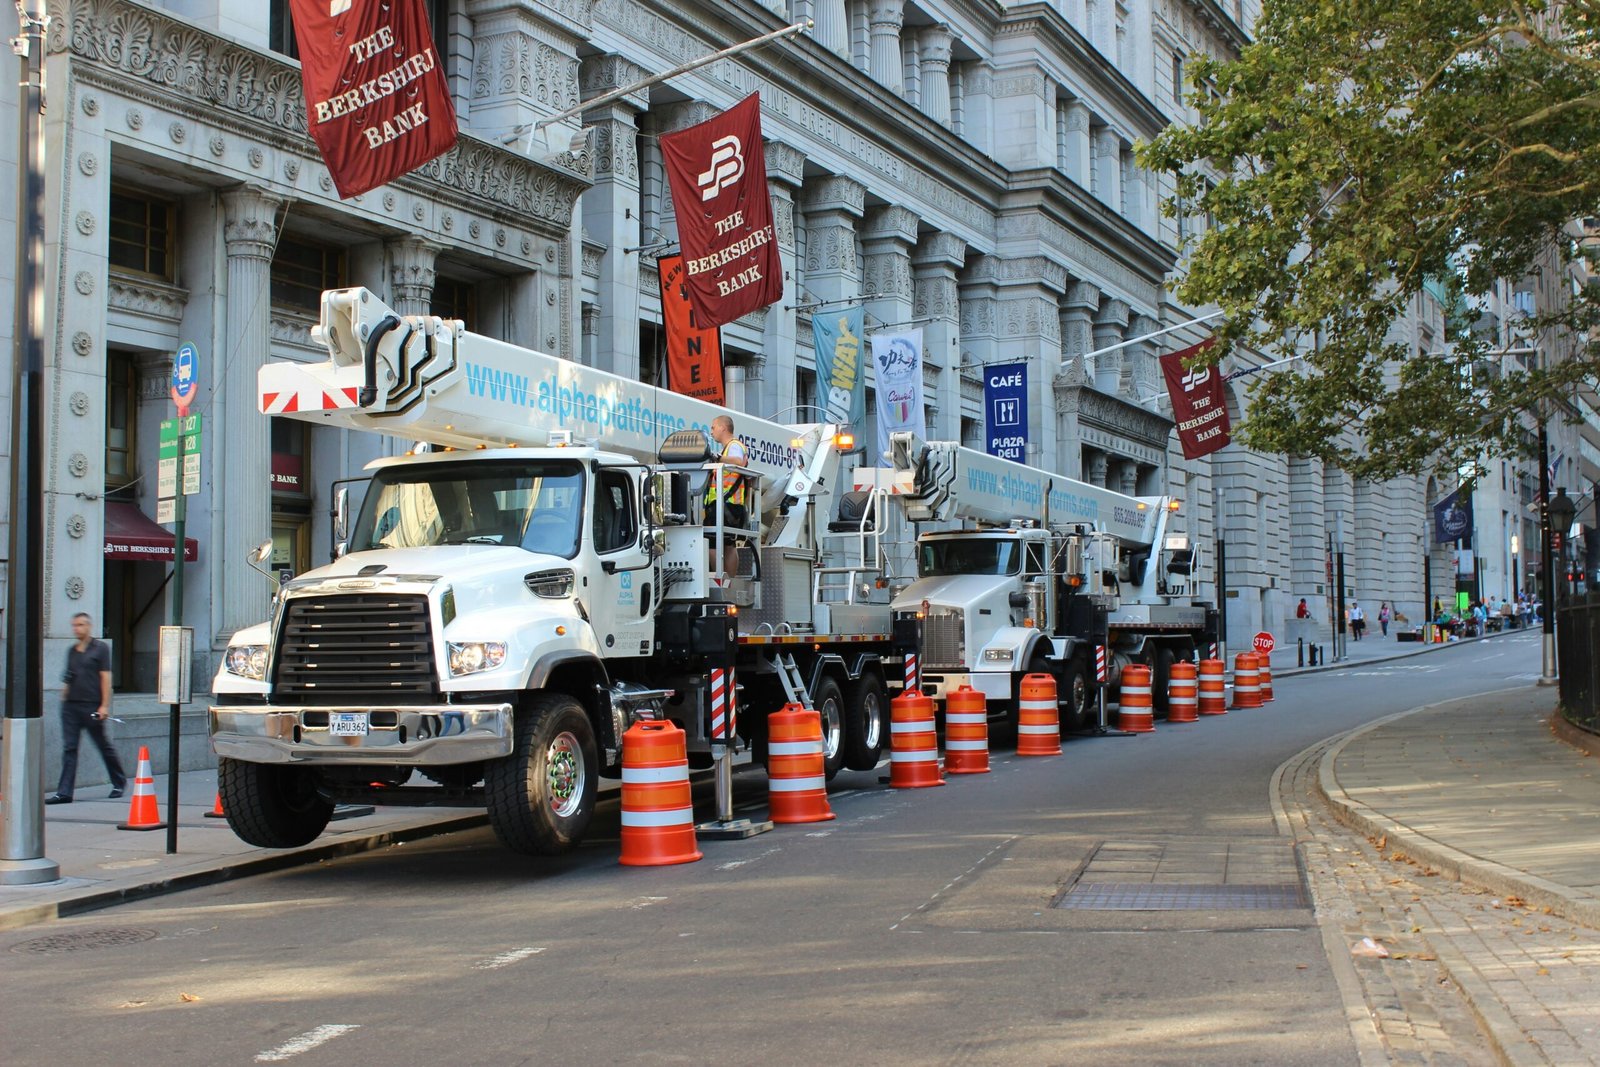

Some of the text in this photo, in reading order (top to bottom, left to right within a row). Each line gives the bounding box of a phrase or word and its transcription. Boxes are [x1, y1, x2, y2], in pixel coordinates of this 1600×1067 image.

[349, 25, 395, 64] THE
[363, 101, 429, 150] BANK
[800, 102, 841, 147] GREEN
[714, 210, 745, 237] THE
[664, 263, 683, 292] NEW
[716, 264, 763, 297] BANK
[825, 316, 859, 427] UBWAY
[990, 371, 1022, 388] CAFÉ
[1192, 396, 1211, 410] THE
[1178, 406, 1225, 432] BERKSHIR
[992, 436, 1025, 448] PLAZA
[1196, 425, 1222, 442] BANK
[997, 447, 1020, 459] DELI
[276, 474, 298, 484] BANK
[130, 545, 170, 554] BERKSHIRE
[1253, 637, 1274, 649] STOP
